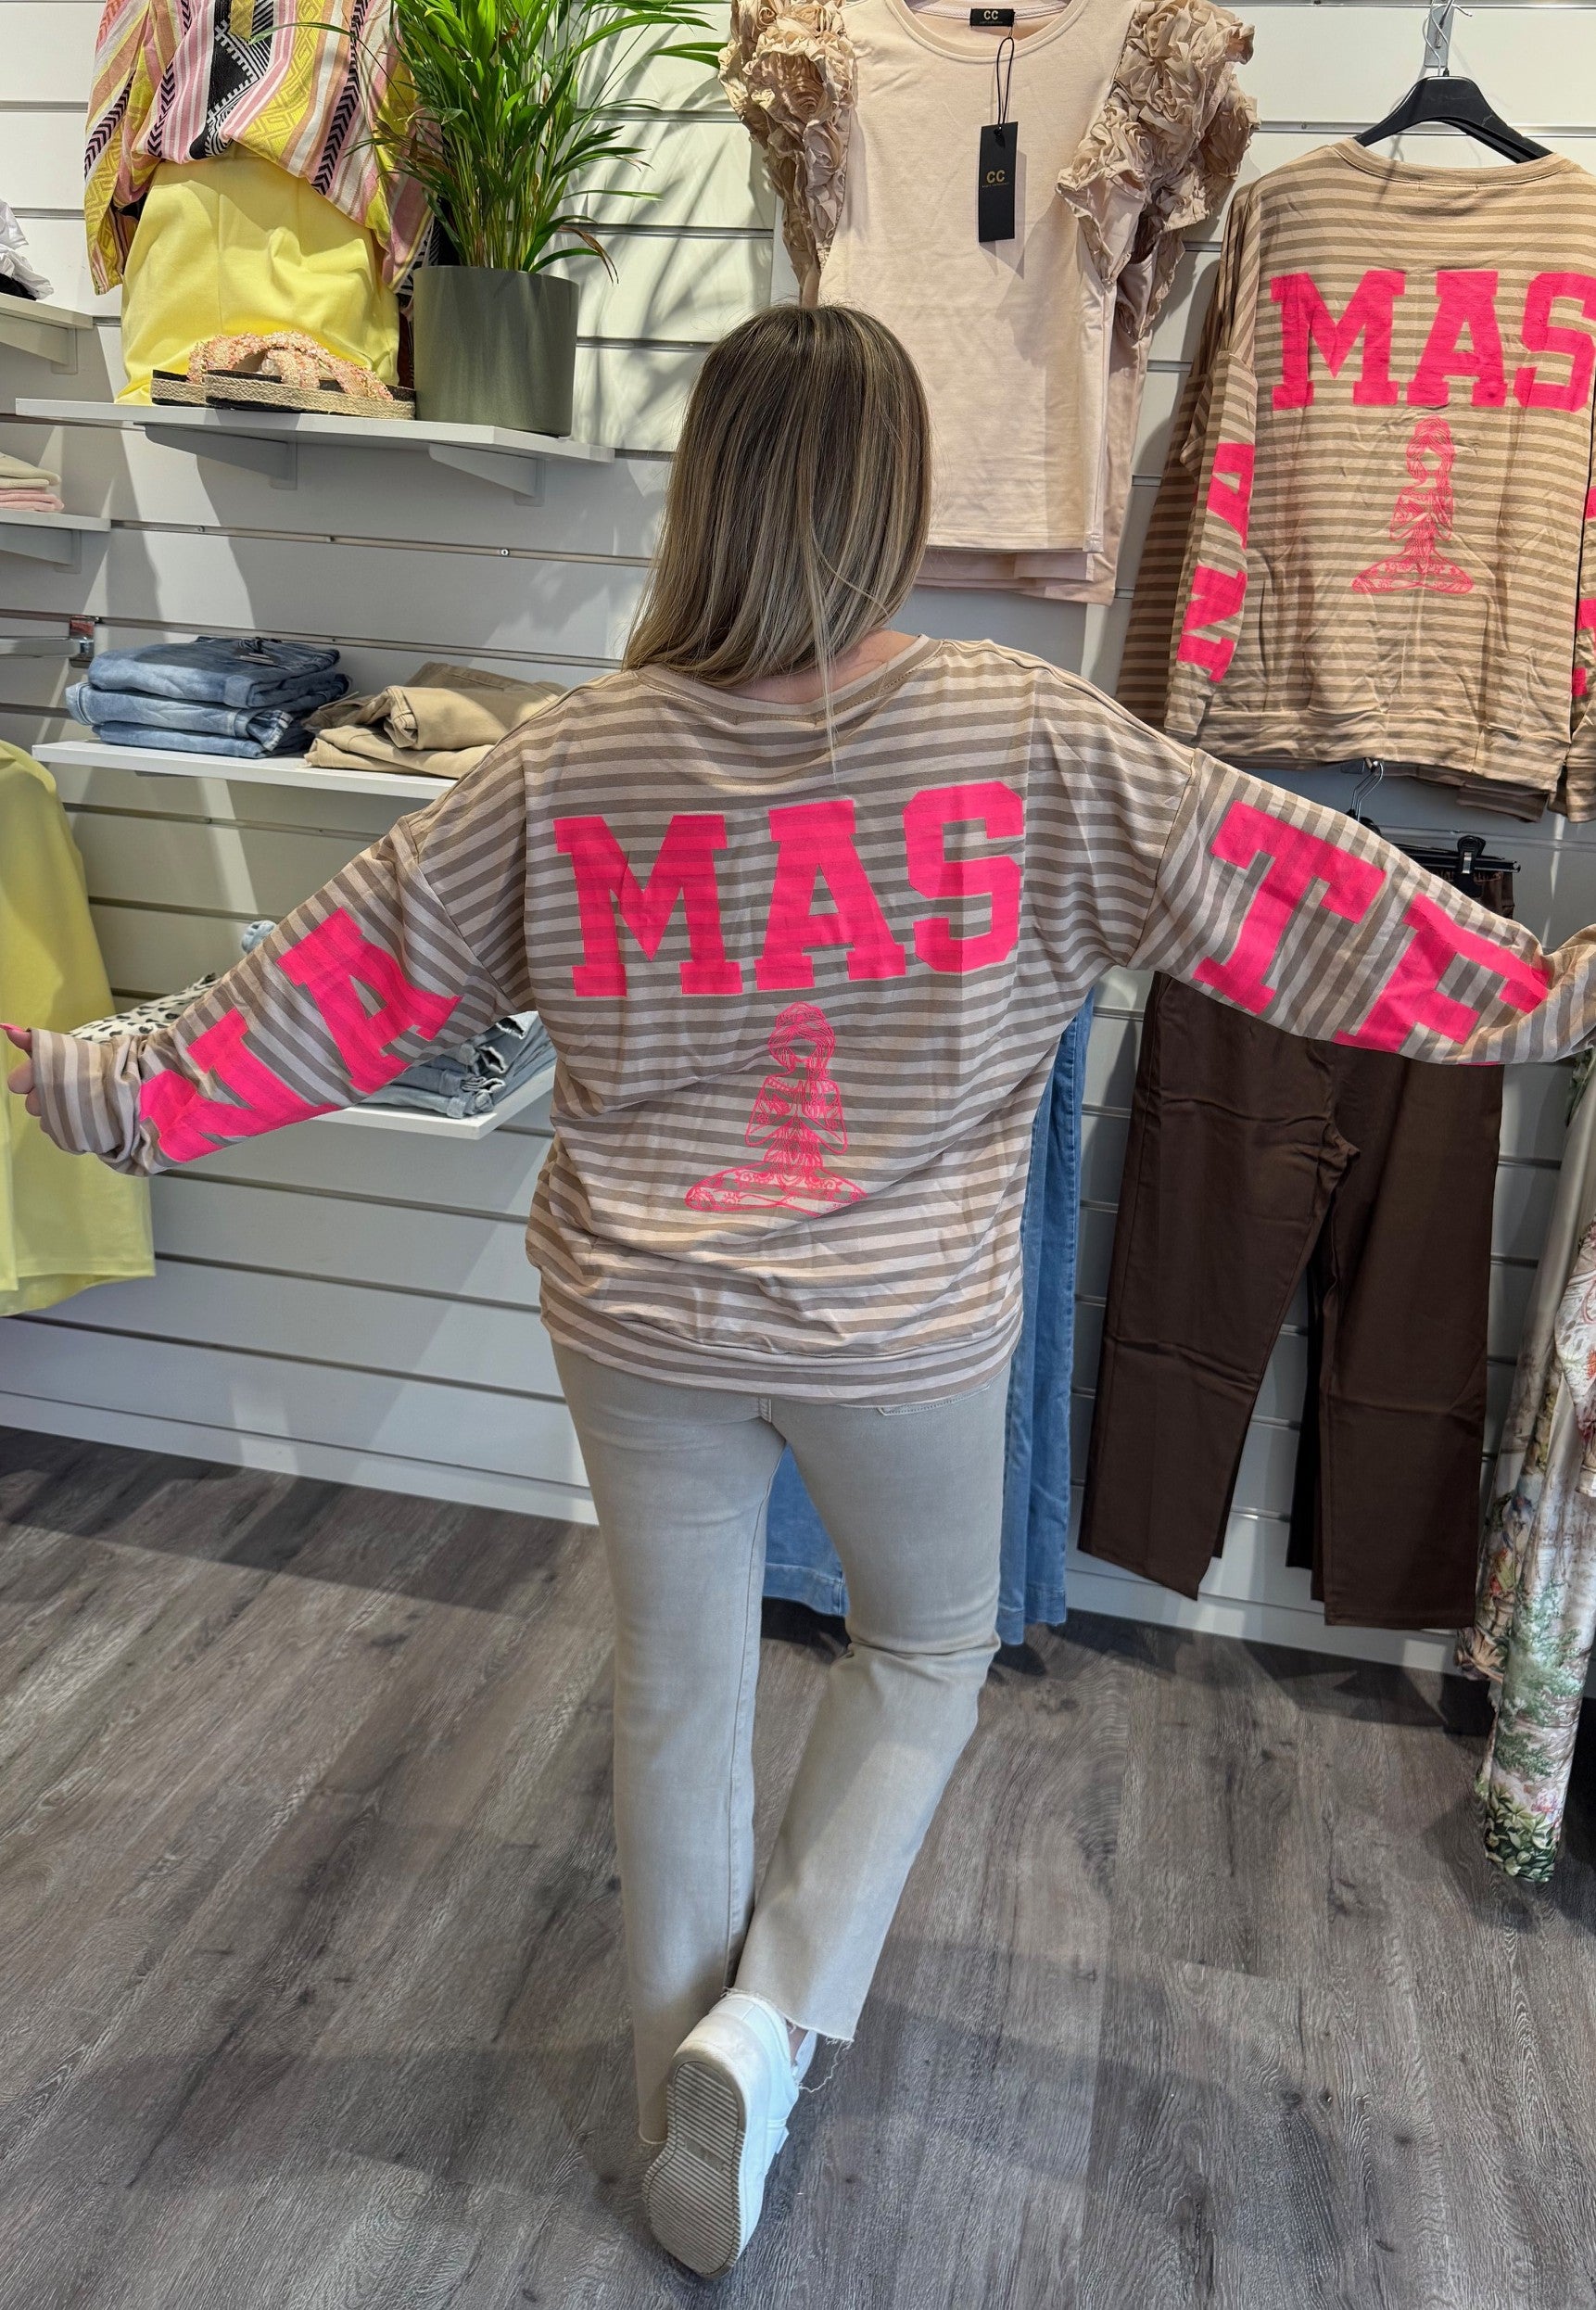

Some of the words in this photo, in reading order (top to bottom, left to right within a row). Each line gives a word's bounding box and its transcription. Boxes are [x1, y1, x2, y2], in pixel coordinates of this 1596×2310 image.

[983, 9, 999, 20] CC
[986, 170, 1006, 184] CC
[1271, 270, 1596, 412] MAS
[553, 781, 1025, 997] MAS
